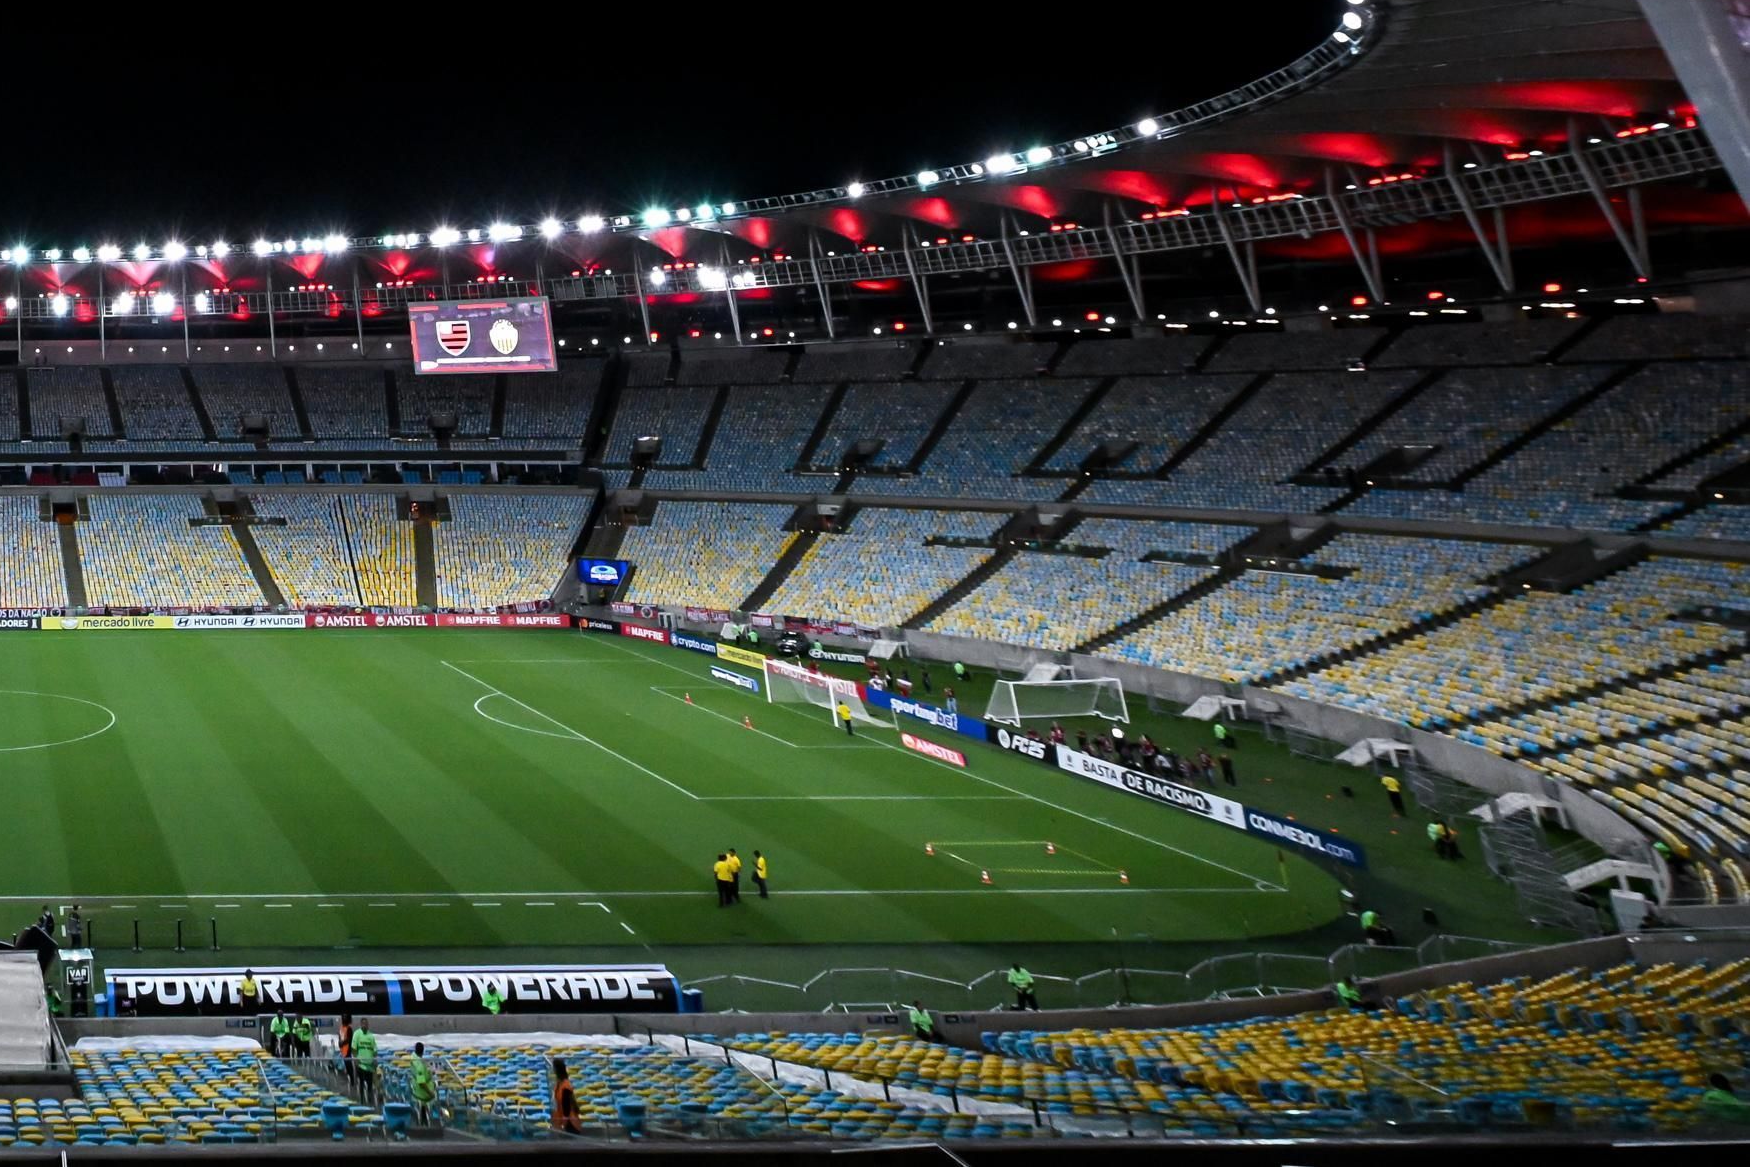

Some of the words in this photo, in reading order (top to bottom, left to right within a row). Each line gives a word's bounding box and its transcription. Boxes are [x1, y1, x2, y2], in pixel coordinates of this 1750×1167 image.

[8, 609, 20, 618] DA
[82, 617, 130, 627] mercado
[132, 617, 154, 627] livre
[194, 618, 237, 626] HYUNDAI
[260, 618, 303, 626] HYUNDAI
[327, 616, 368, 627] AMSTEL
[387, 615, 428, 626] AMSTEL
[456, 616, 500, 625] MAPFRE
[516, 616, 561, 625] MAPFRE
[589, 619, 613, 631] priceless
[631, 625, 664, 642] MAPFRE
[678, 637, 716, 653] crypto.com
[890, 698, 958, 731] sportingbet
[915, 738, 961, 766] AMSTEL
[1011, 735, 1047, 760] FC25
[1082, 759, 1118, 782] BASTA
[1126, 773, 1145, 791] DE
[1145, 778, 1205, 810] RACISMO
[69, 968, 87, 978] VAR
[408, 974, 656, 1002] POWERADE
